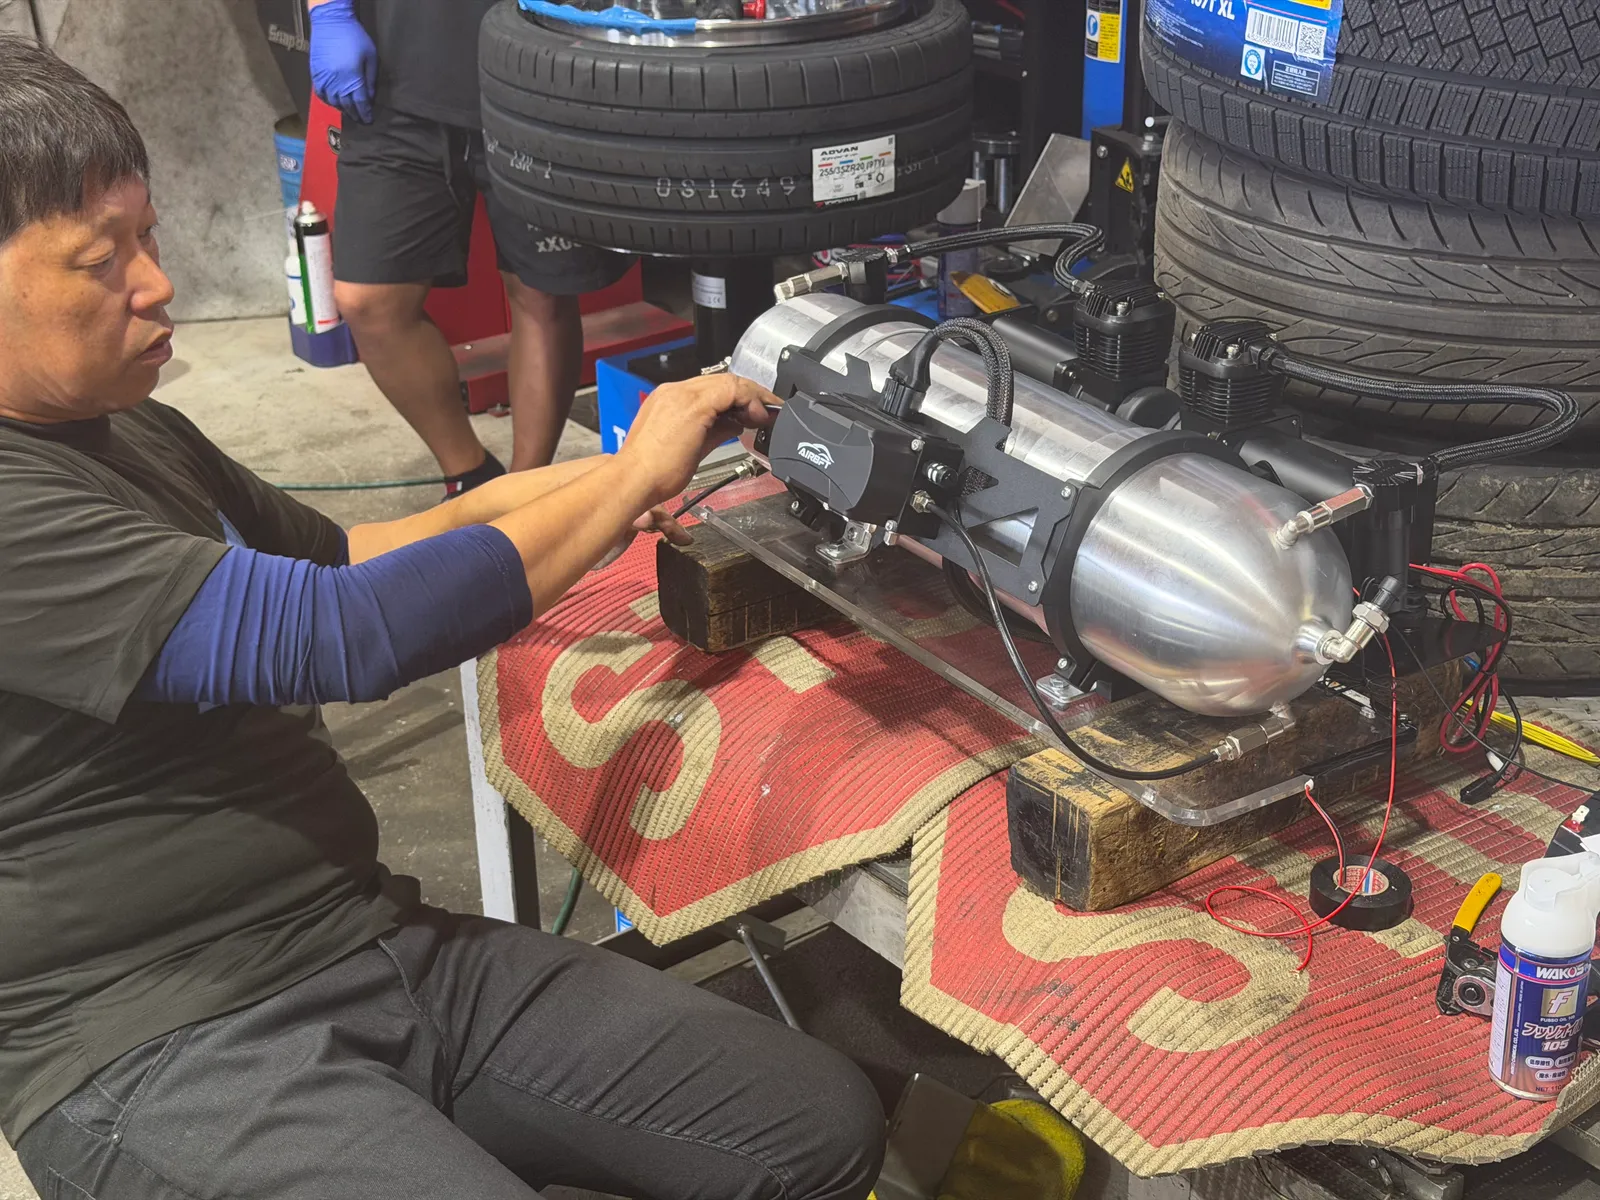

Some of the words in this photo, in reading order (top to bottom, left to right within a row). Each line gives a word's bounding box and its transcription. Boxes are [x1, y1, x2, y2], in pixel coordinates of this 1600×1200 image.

[1217, 0, 1236, 20] XL
[820, 146, 859, 156] ADVAN
[820, 162, 865, 177] 255/35ZR20
[798, 447, 832, 469] AIRBFT
[1542, 1038, 1570, 1052] 105
